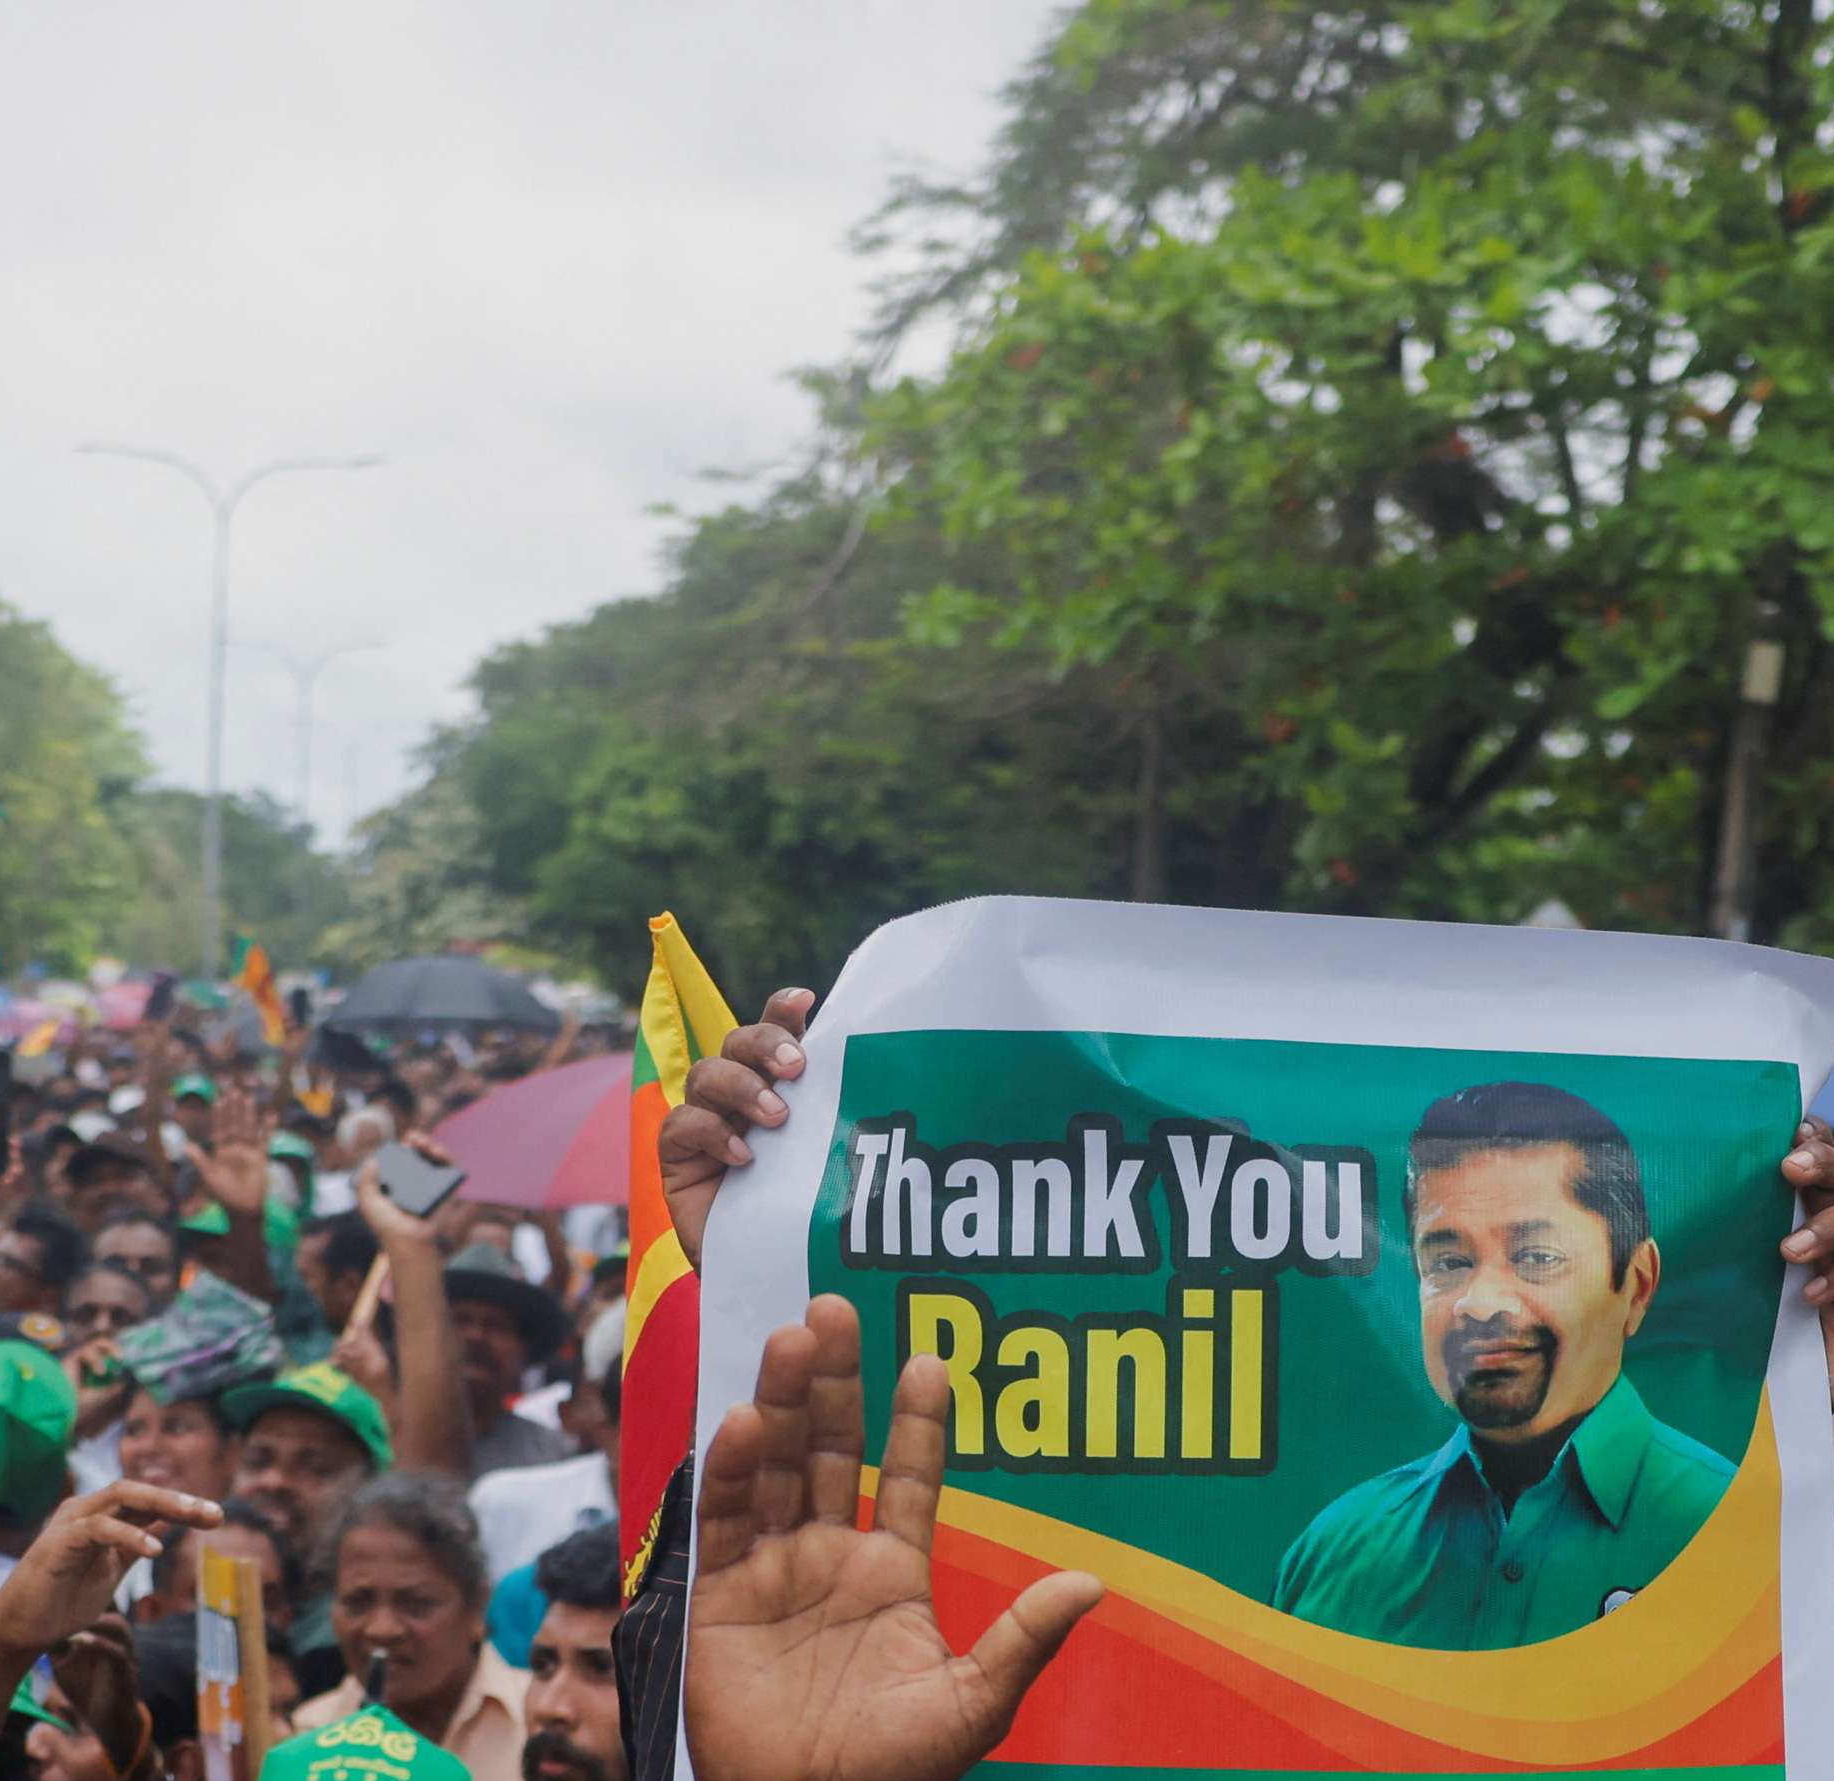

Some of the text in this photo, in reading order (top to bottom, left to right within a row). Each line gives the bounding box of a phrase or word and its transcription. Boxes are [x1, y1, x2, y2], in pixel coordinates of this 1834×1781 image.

[843, 1126, 1366, 1263] Thank You
[906, 1288, 1265, 1462] Ranil
